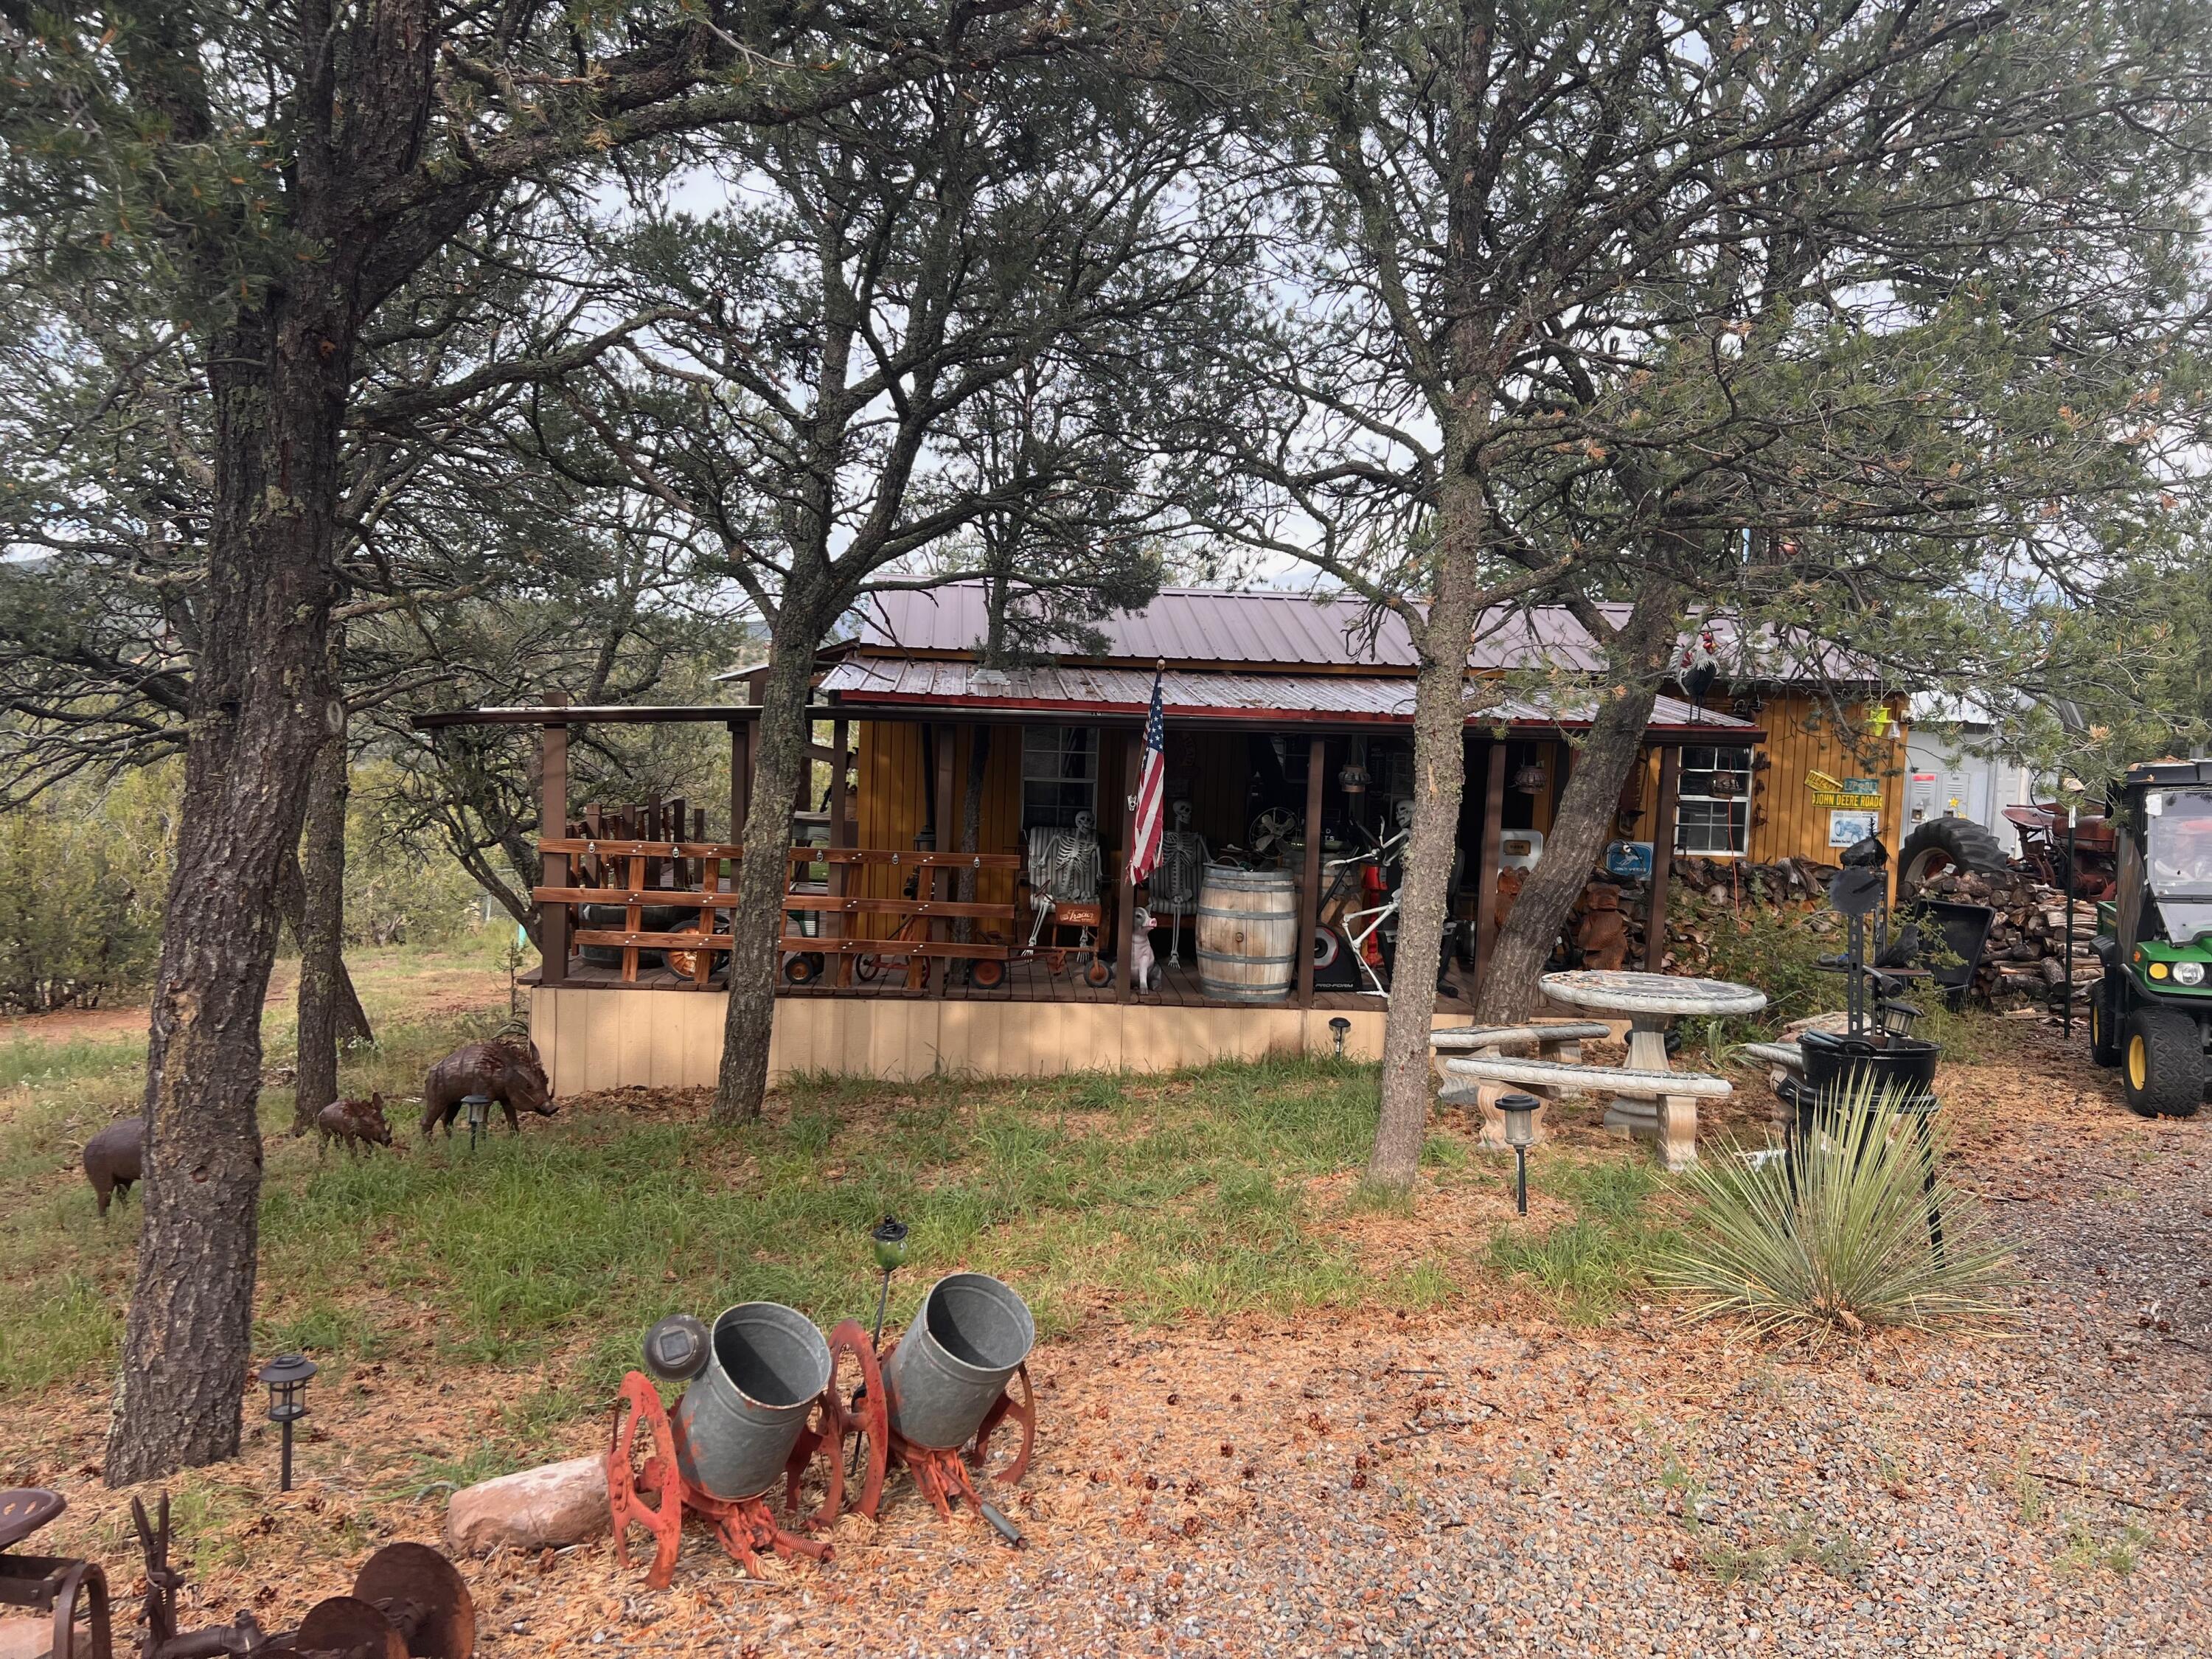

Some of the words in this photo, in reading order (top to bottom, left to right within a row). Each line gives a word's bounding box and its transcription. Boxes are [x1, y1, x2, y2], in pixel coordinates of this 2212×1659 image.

[1816, 794, 1834, 805] JOHN
[1837, 795, 1858, 807] DEERE
[1860, 796, 1878, 807] ROAD
